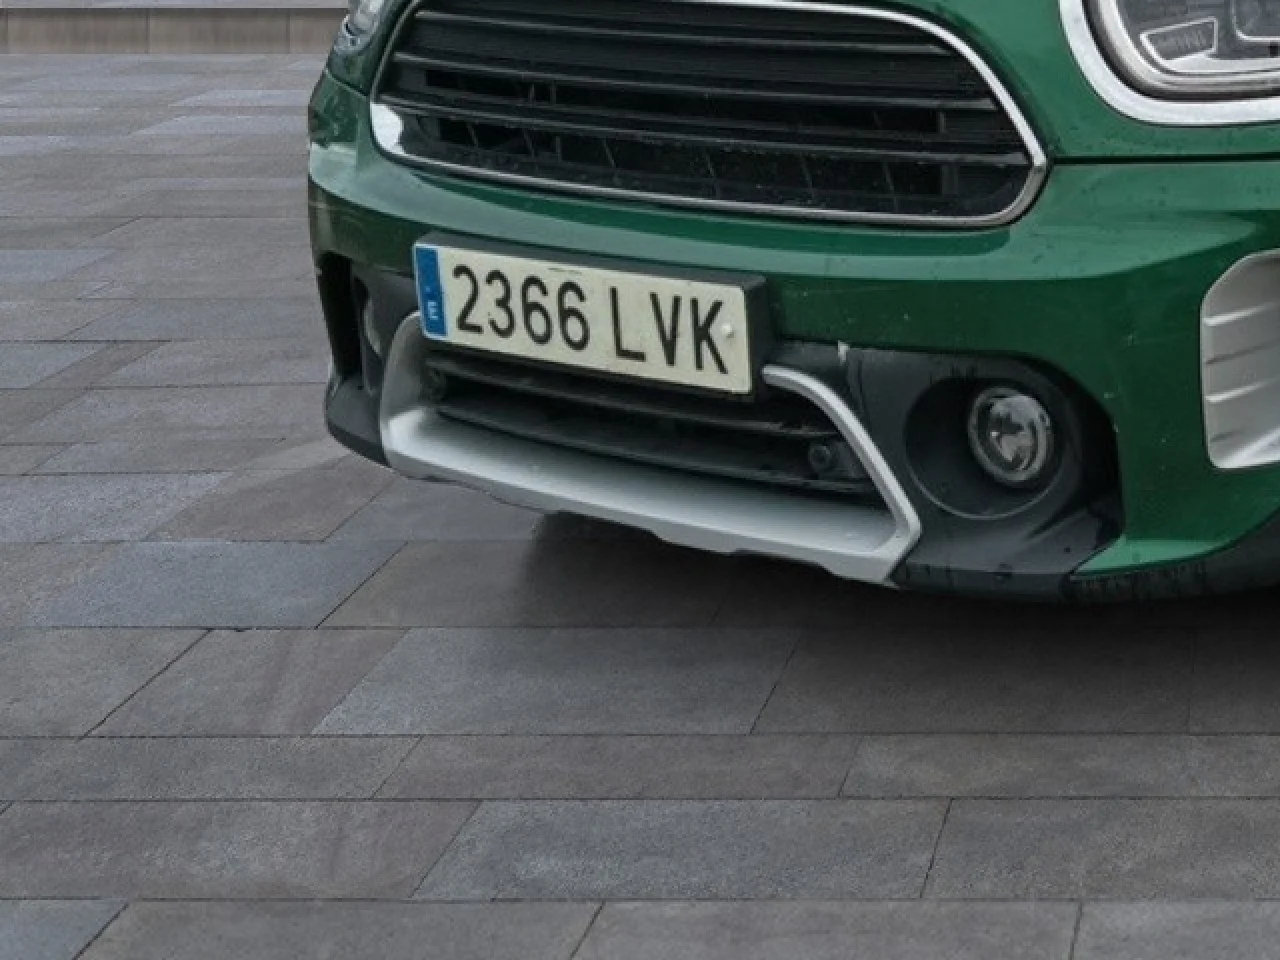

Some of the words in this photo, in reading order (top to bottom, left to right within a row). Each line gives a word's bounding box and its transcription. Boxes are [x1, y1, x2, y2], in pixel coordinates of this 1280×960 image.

[427, 300, 439, 321] E
[452, 265, 590, 351] 2366
[610, 286, 728, 375] LVK
